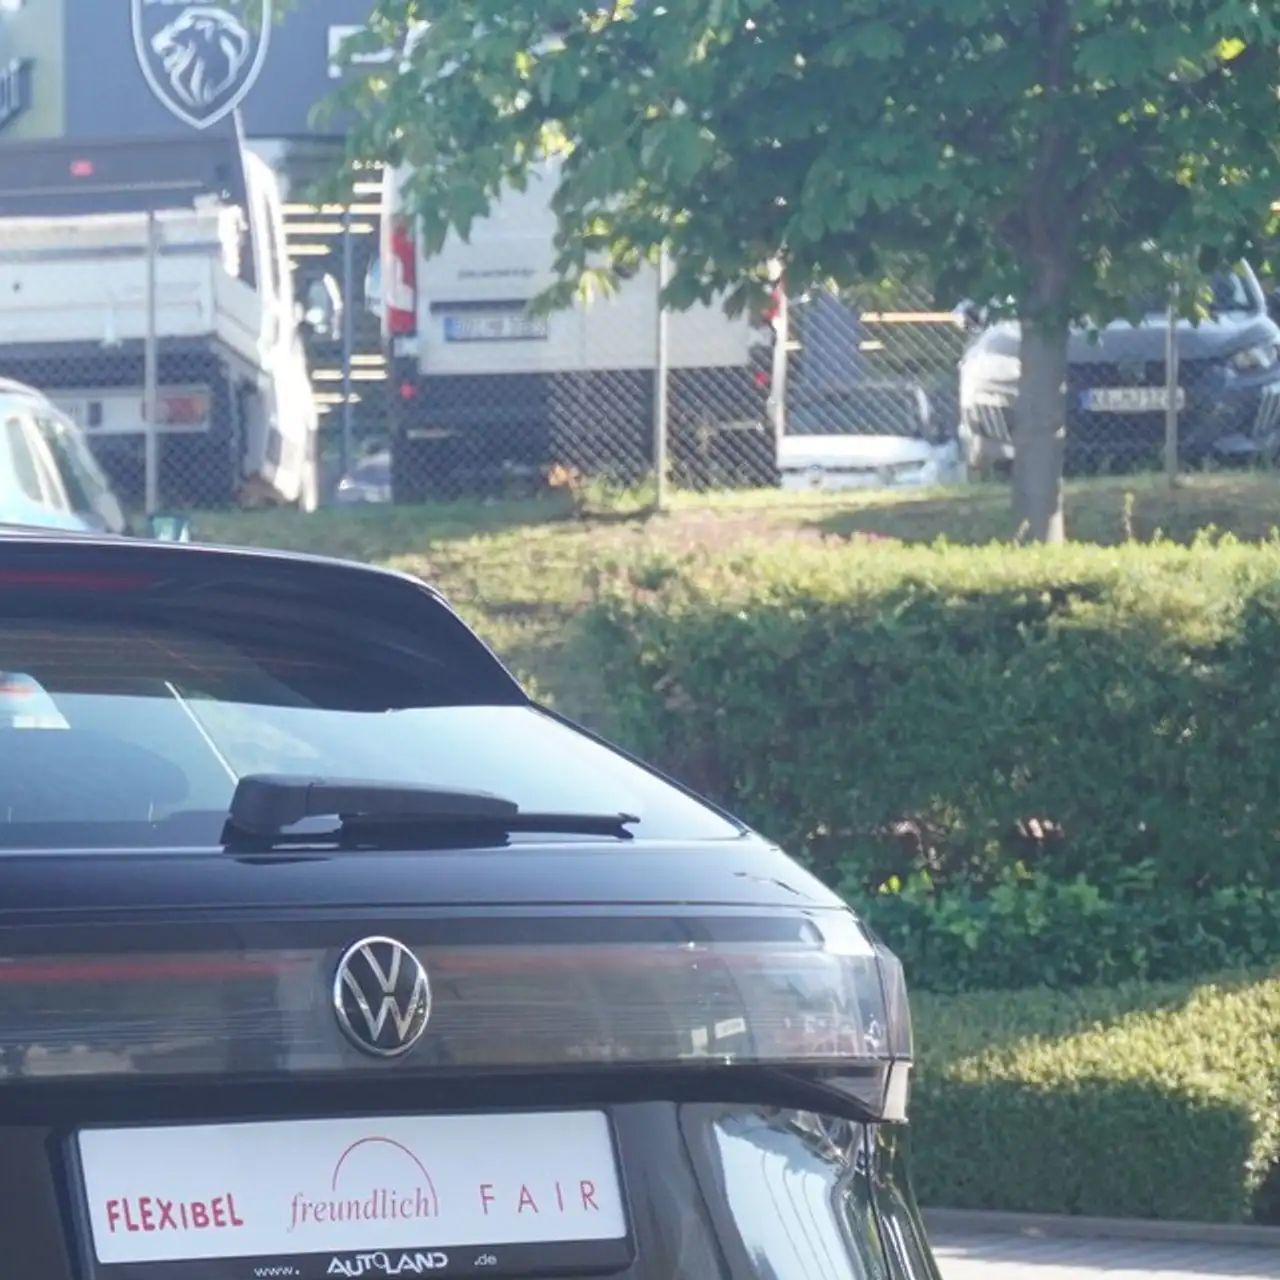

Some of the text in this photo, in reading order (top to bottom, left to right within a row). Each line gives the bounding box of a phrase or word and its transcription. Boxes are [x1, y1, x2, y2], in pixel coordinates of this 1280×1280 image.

[105, 1179, 600, 1233] FLEXIBEL freundlich FAIR
[253, 1250, 498, 1279] www. AUTOLAND .de
